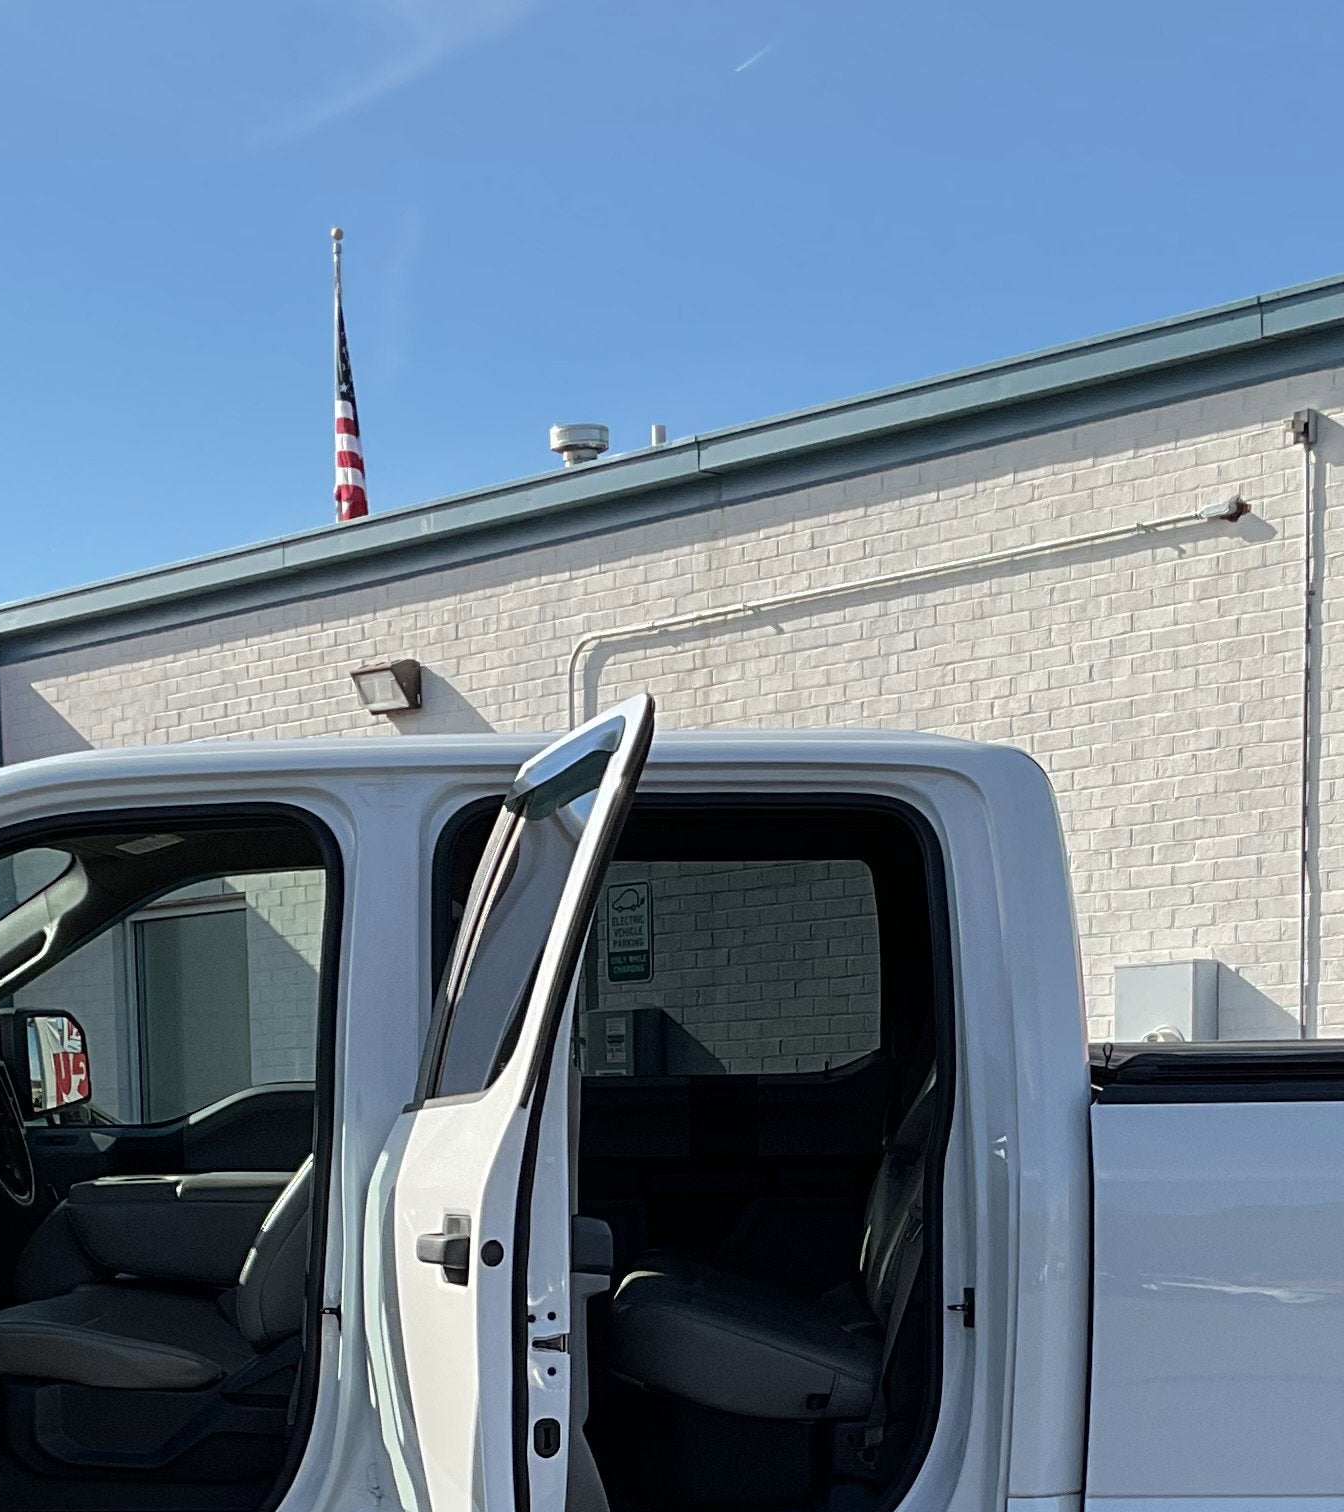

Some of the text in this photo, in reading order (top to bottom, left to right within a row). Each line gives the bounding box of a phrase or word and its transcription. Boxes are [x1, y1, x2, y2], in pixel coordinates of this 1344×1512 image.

[611, 914, 644, 927] ELECTRIC
[613, 925, 644, 938] VEHICLE
[612, 937, 644, 949] PARKING
